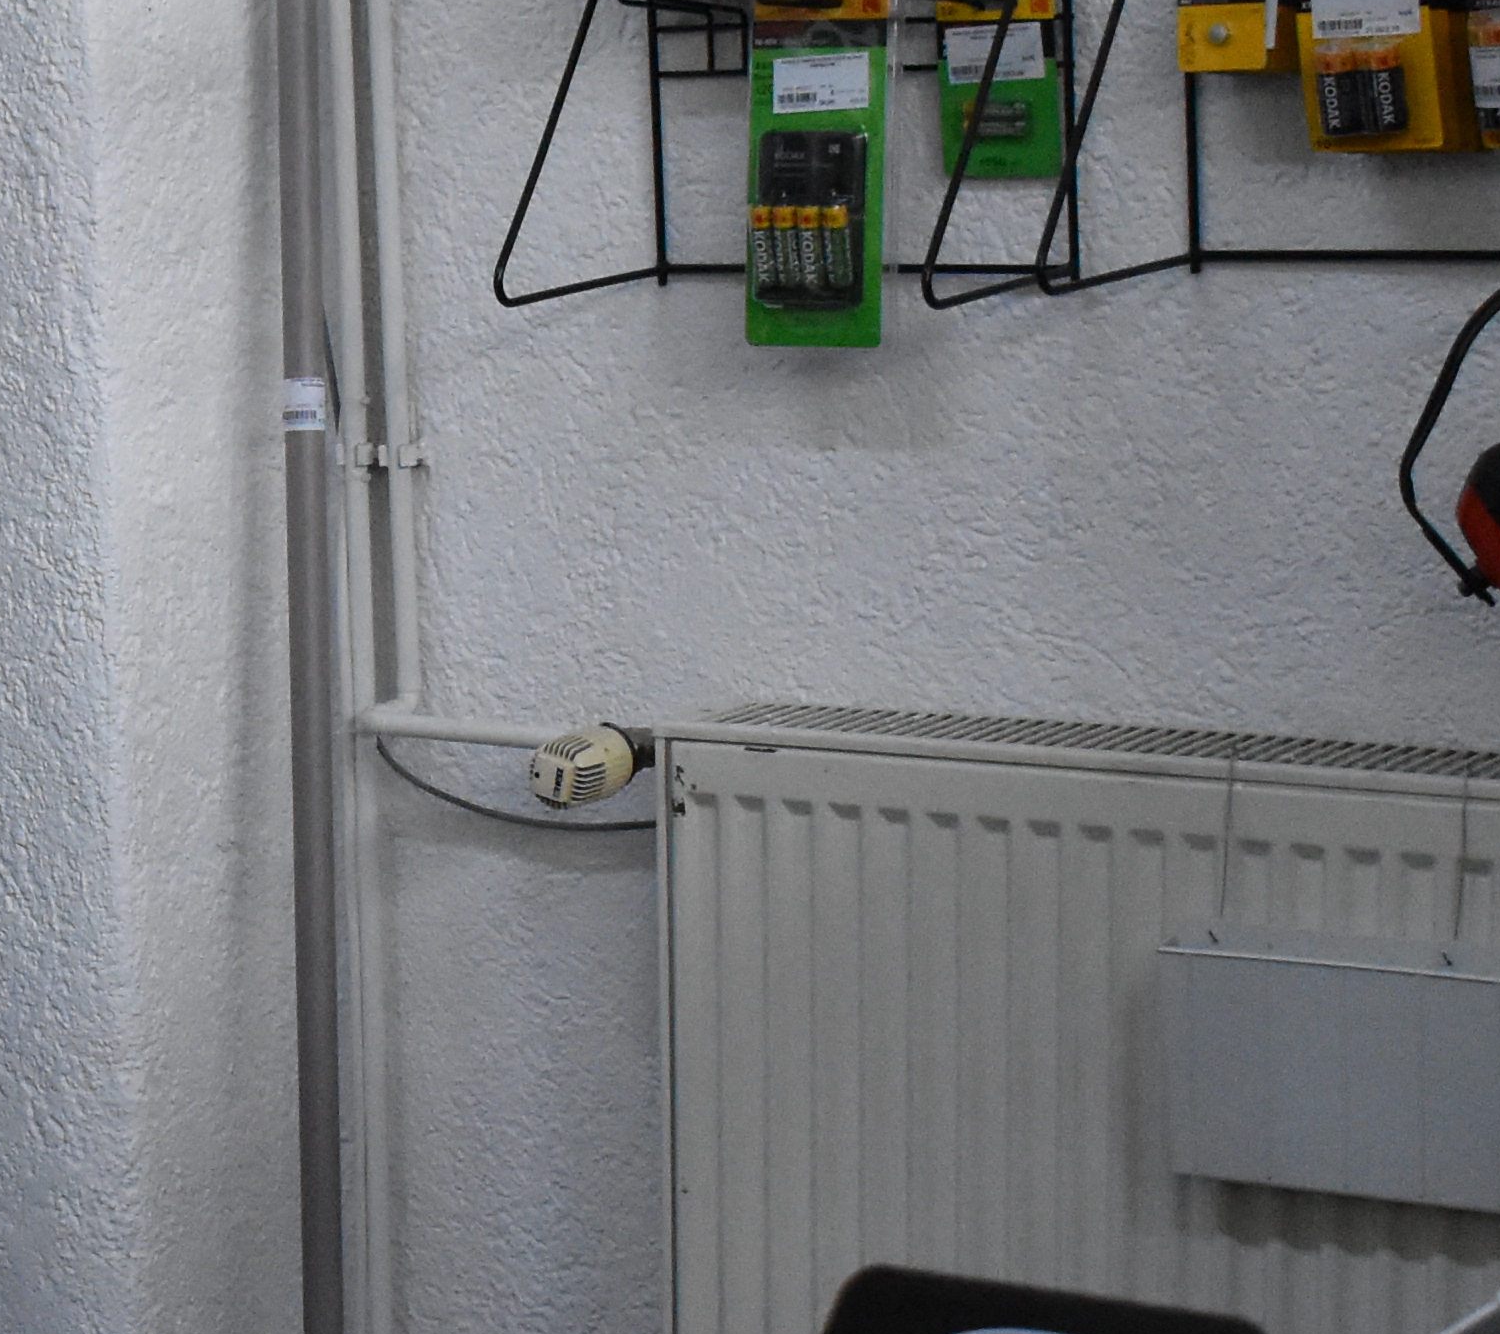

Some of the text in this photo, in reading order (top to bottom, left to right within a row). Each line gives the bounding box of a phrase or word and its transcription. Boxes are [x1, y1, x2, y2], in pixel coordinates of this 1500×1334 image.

[1323, 75, 1342, 129] KODAK
[1377, 70, 1396, 125] KODAK
[754, 229, 771, 284] KODAK
[801, 229, 819, 285] KODAK
